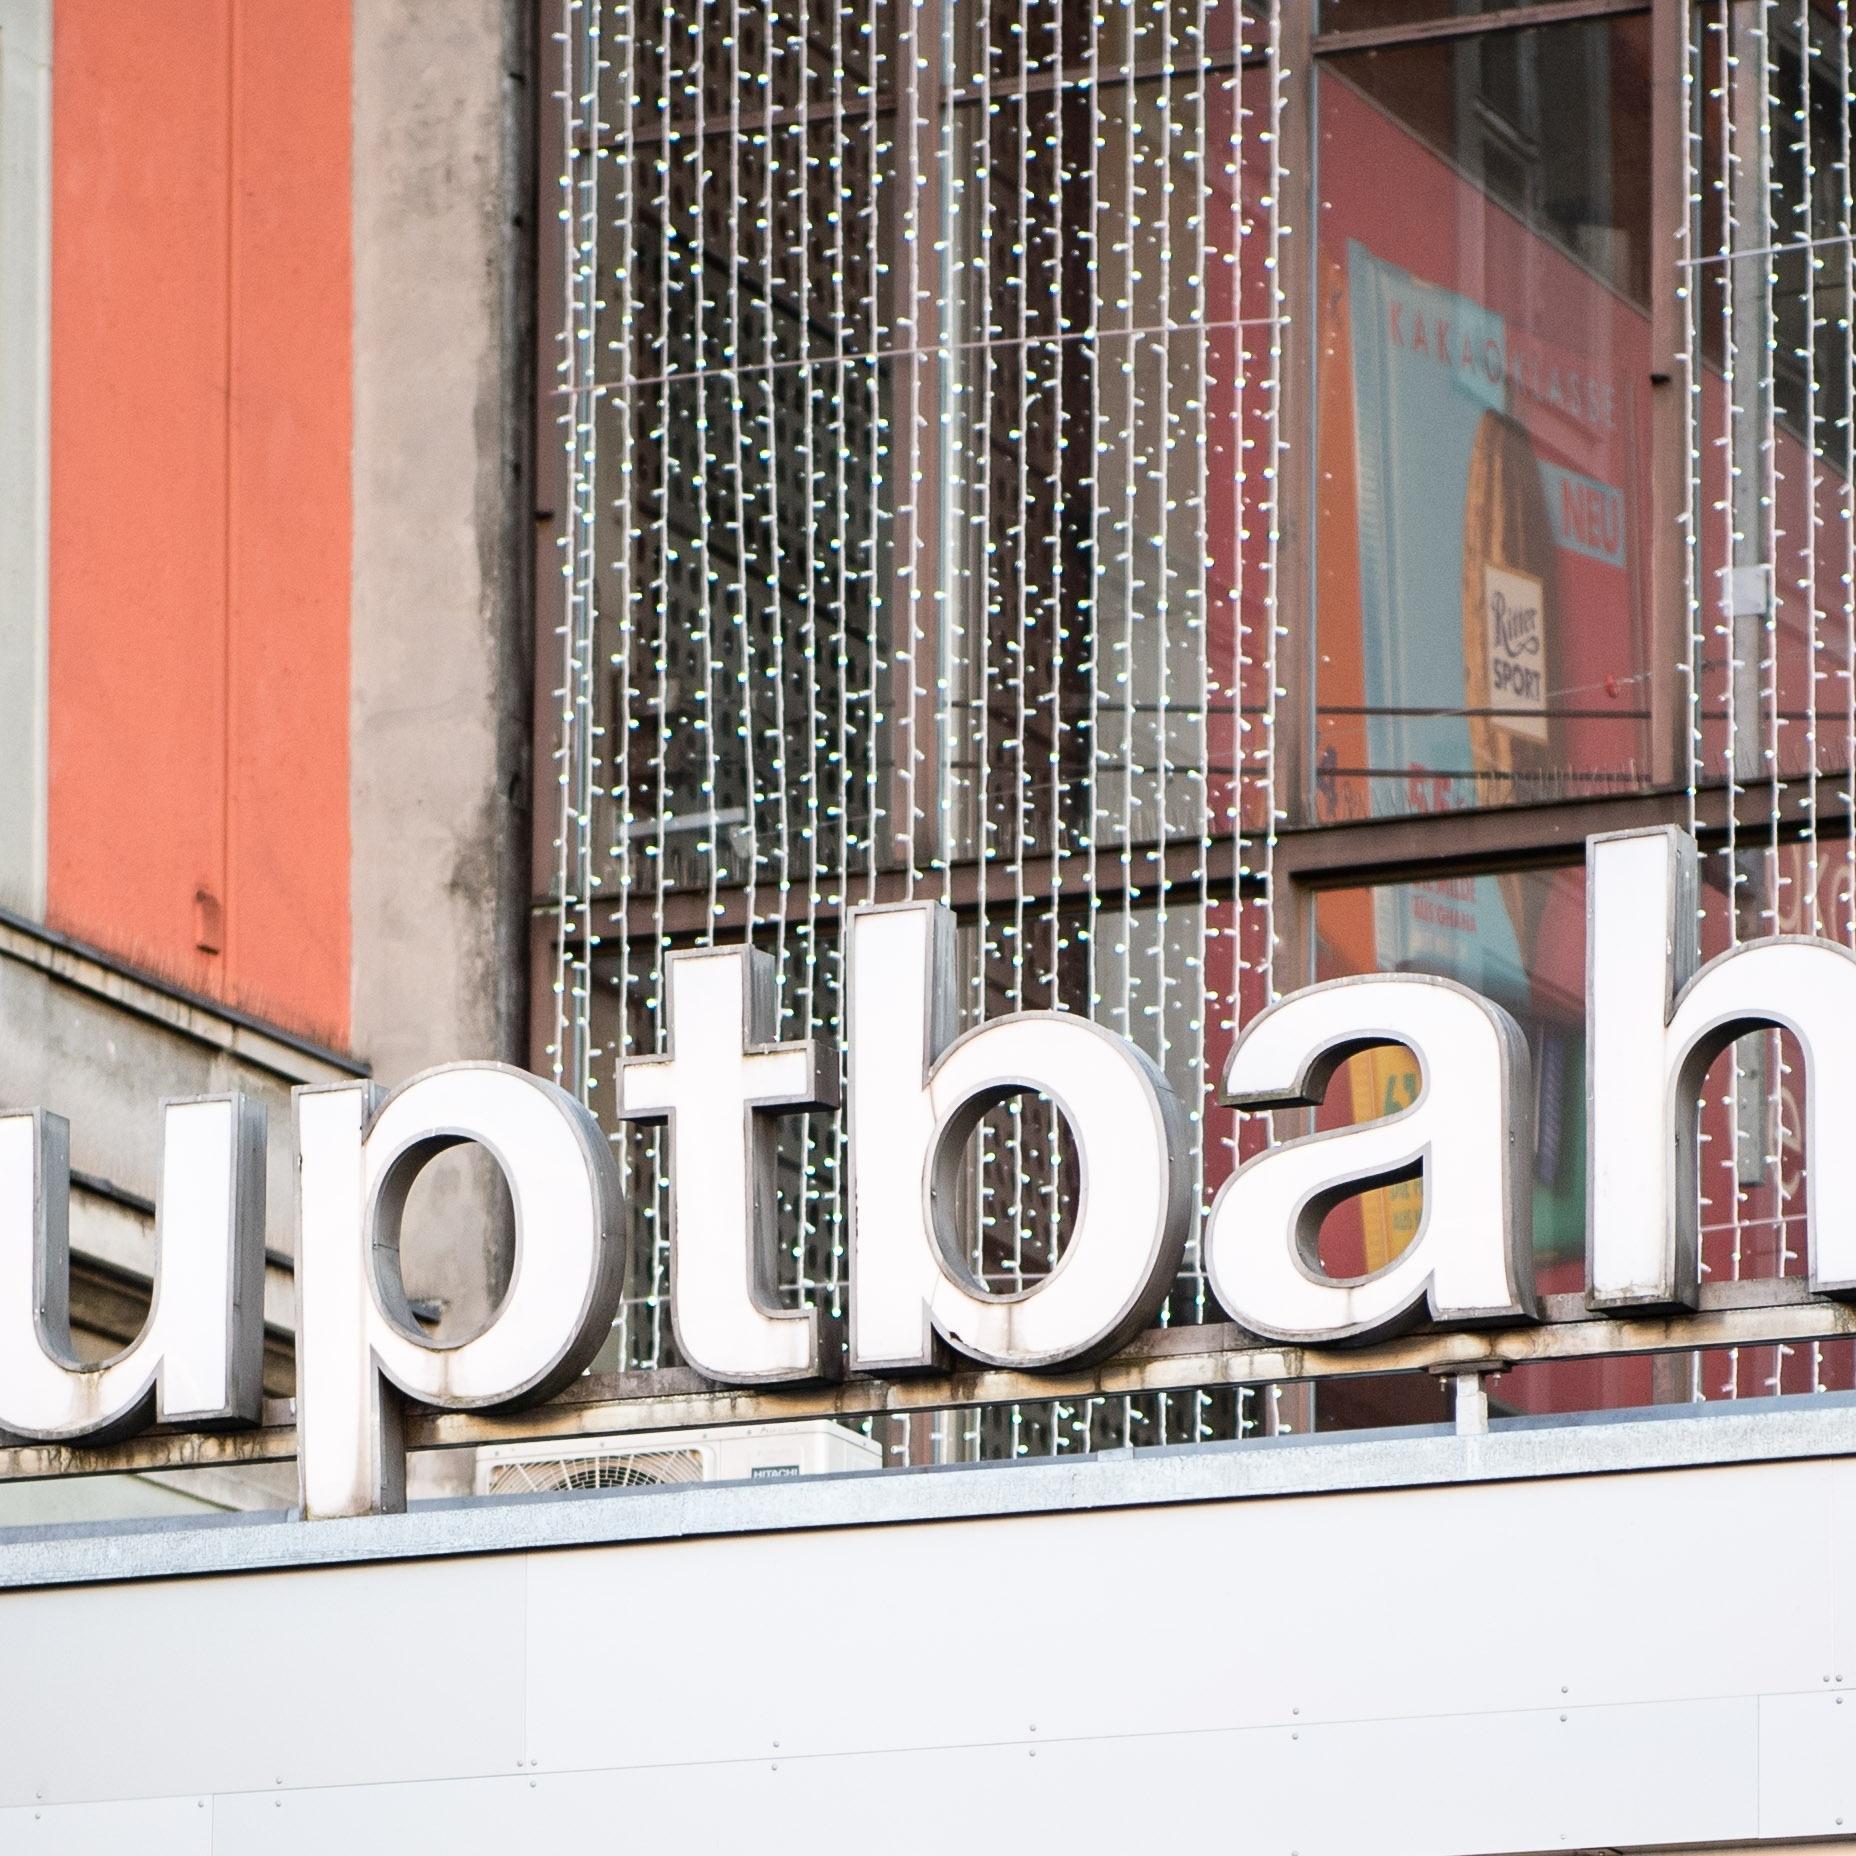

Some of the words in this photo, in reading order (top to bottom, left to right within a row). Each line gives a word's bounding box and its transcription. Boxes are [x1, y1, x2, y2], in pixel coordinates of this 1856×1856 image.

[1561, 478, 1620, 554] NEU
[1491, 591, 1540, 657] Ritter
[1494, 657, 1540, 701] SPORT
